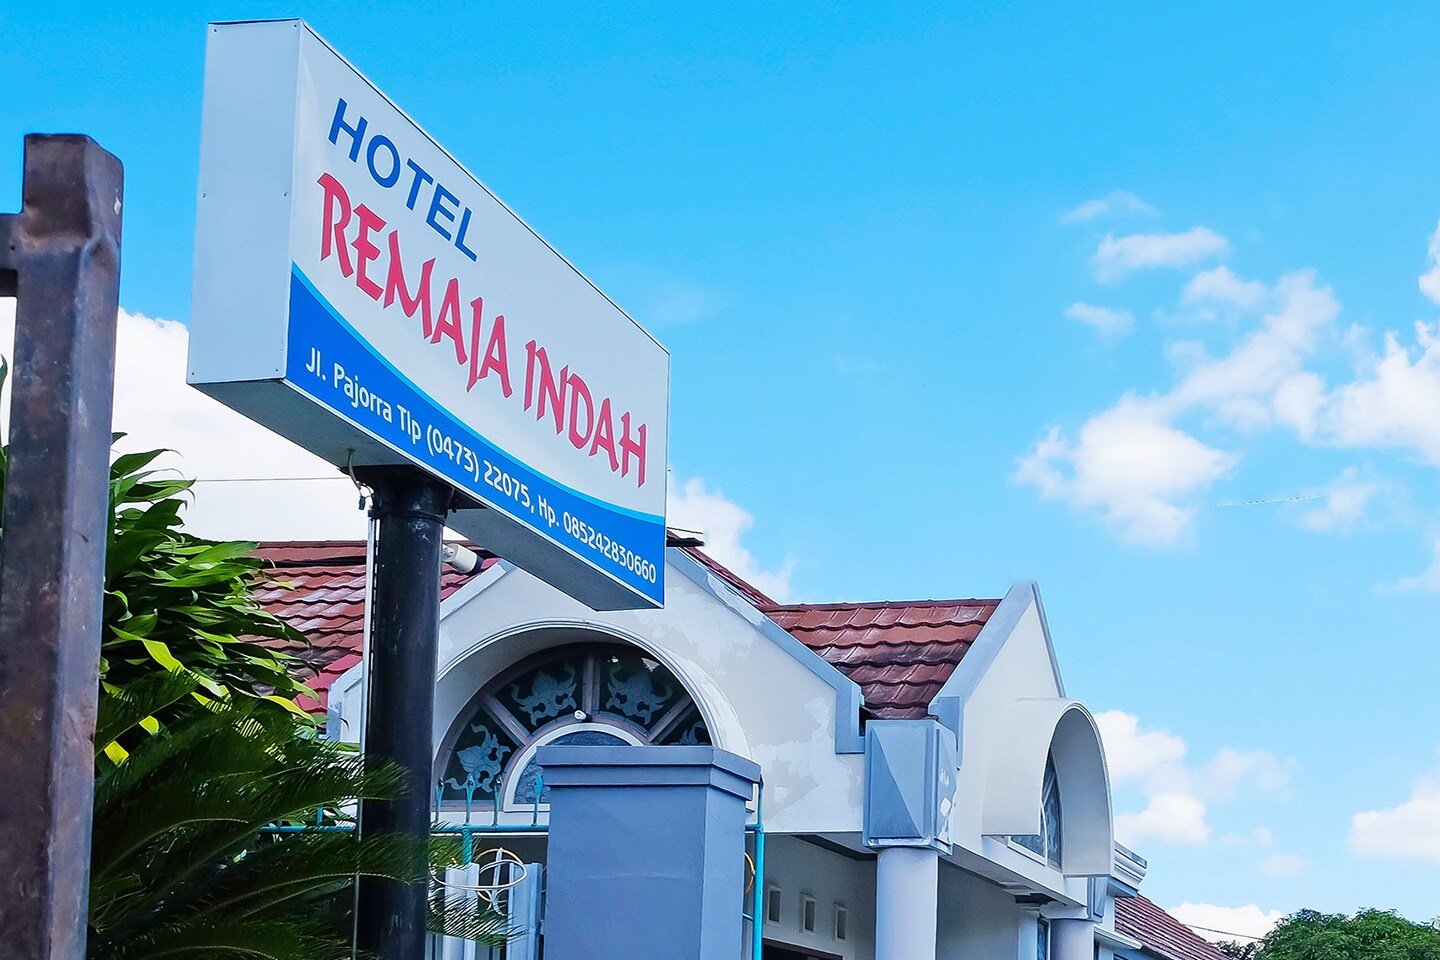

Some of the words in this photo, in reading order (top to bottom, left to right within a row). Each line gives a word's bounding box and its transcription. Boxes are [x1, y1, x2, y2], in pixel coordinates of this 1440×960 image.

[328, 97, 478, 262] HOTEL
[317, 172, 513, 398] REMAJA
[523, 340, 646, 488] INDAH
[306, 347, 326, 381] Jl.
[333, 362, 393, 423] Pajorra
[397, 404, 421, 444] Tlp
[427, 424, 479, 483] (0473)
[484, 460, 535, 514] 22075,
[538, 495, 560, 528] Hp.
[563, 511, 657, 584] 085242830660
